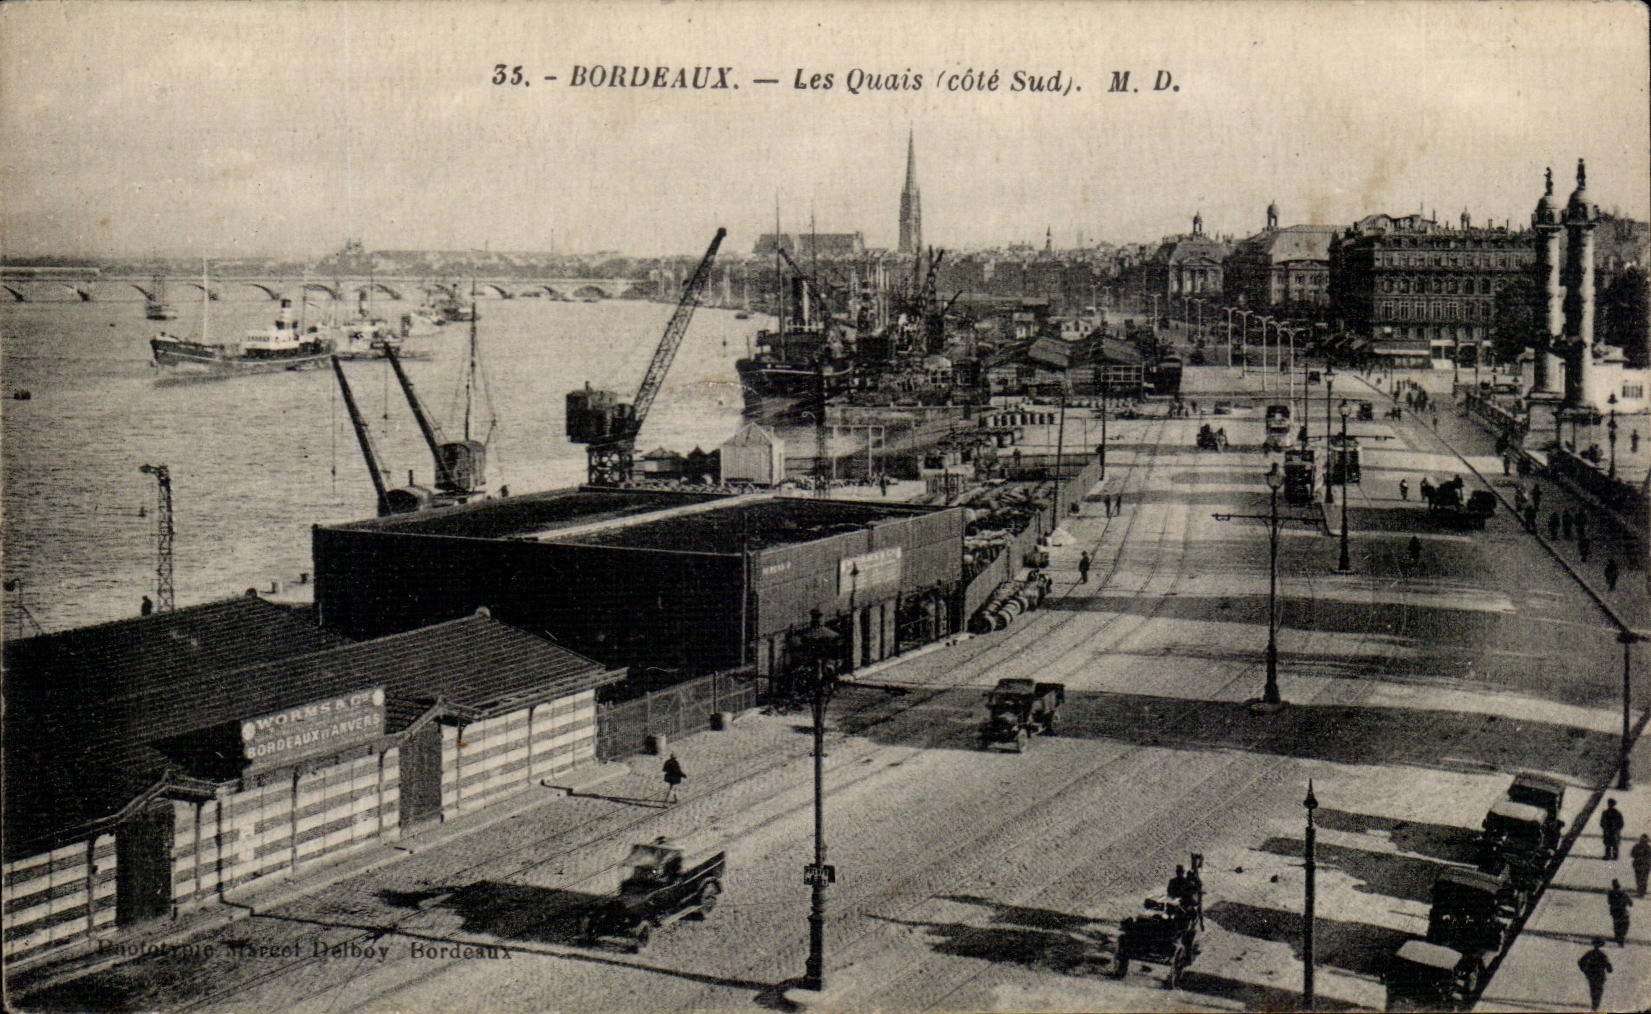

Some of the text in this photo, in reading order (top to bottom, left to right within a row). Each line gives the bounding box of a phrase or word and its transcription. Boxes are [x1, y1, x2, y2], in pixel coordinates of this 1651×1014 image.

[255, 702, 331, 730] WORMS
[246, 729, 319, 760] BORDEAUX
[331, 713, 381, 737] ANVERS
